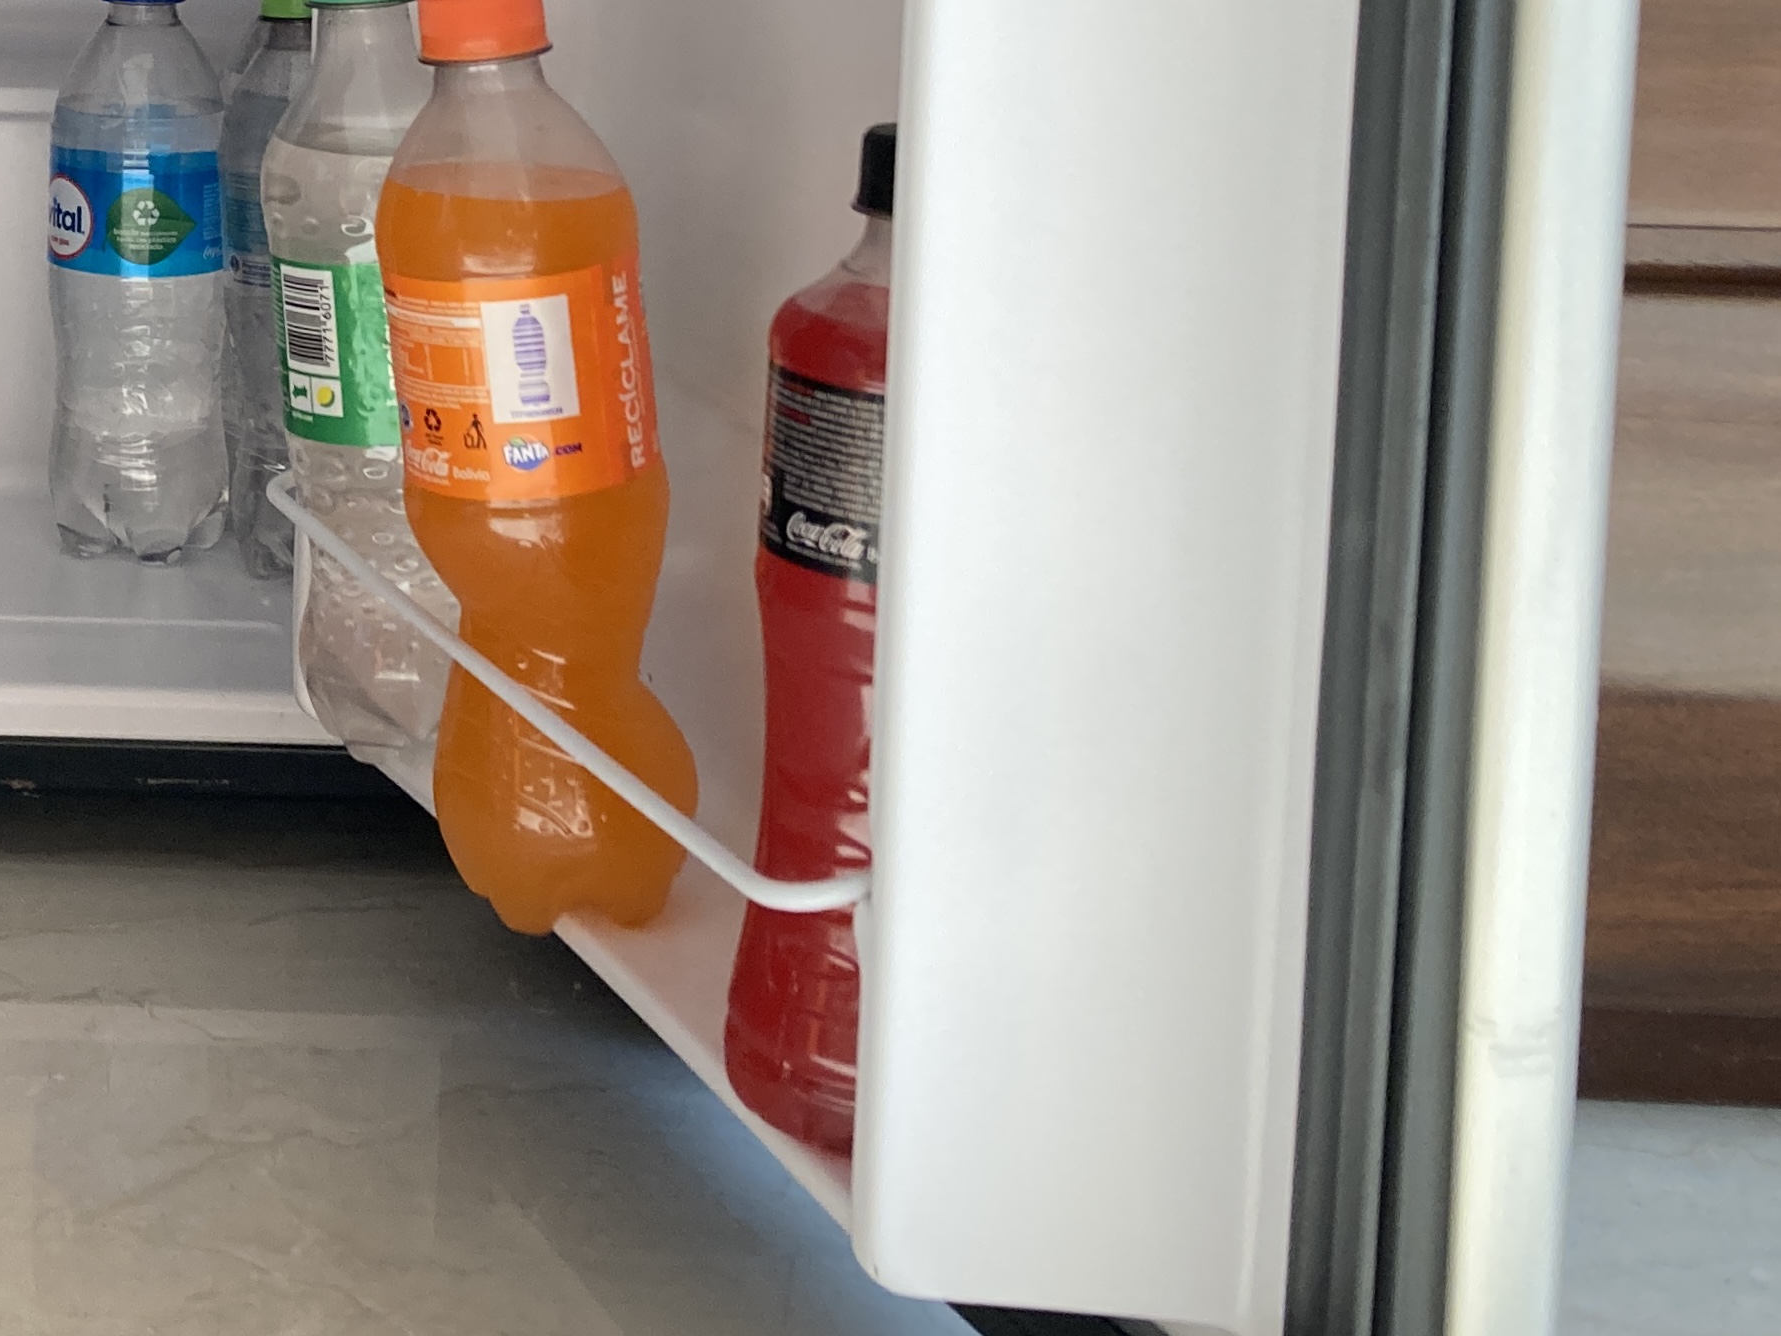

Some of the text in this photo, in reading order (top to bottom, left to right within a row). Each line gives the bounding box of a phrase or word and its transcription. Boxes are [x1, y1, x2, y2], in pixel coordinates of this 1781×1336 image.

[319, 284, 335, 366] 7771 6071
[610, 270, 648, 468] RECICLAME
[502, 441, 550, 465] FANTA
